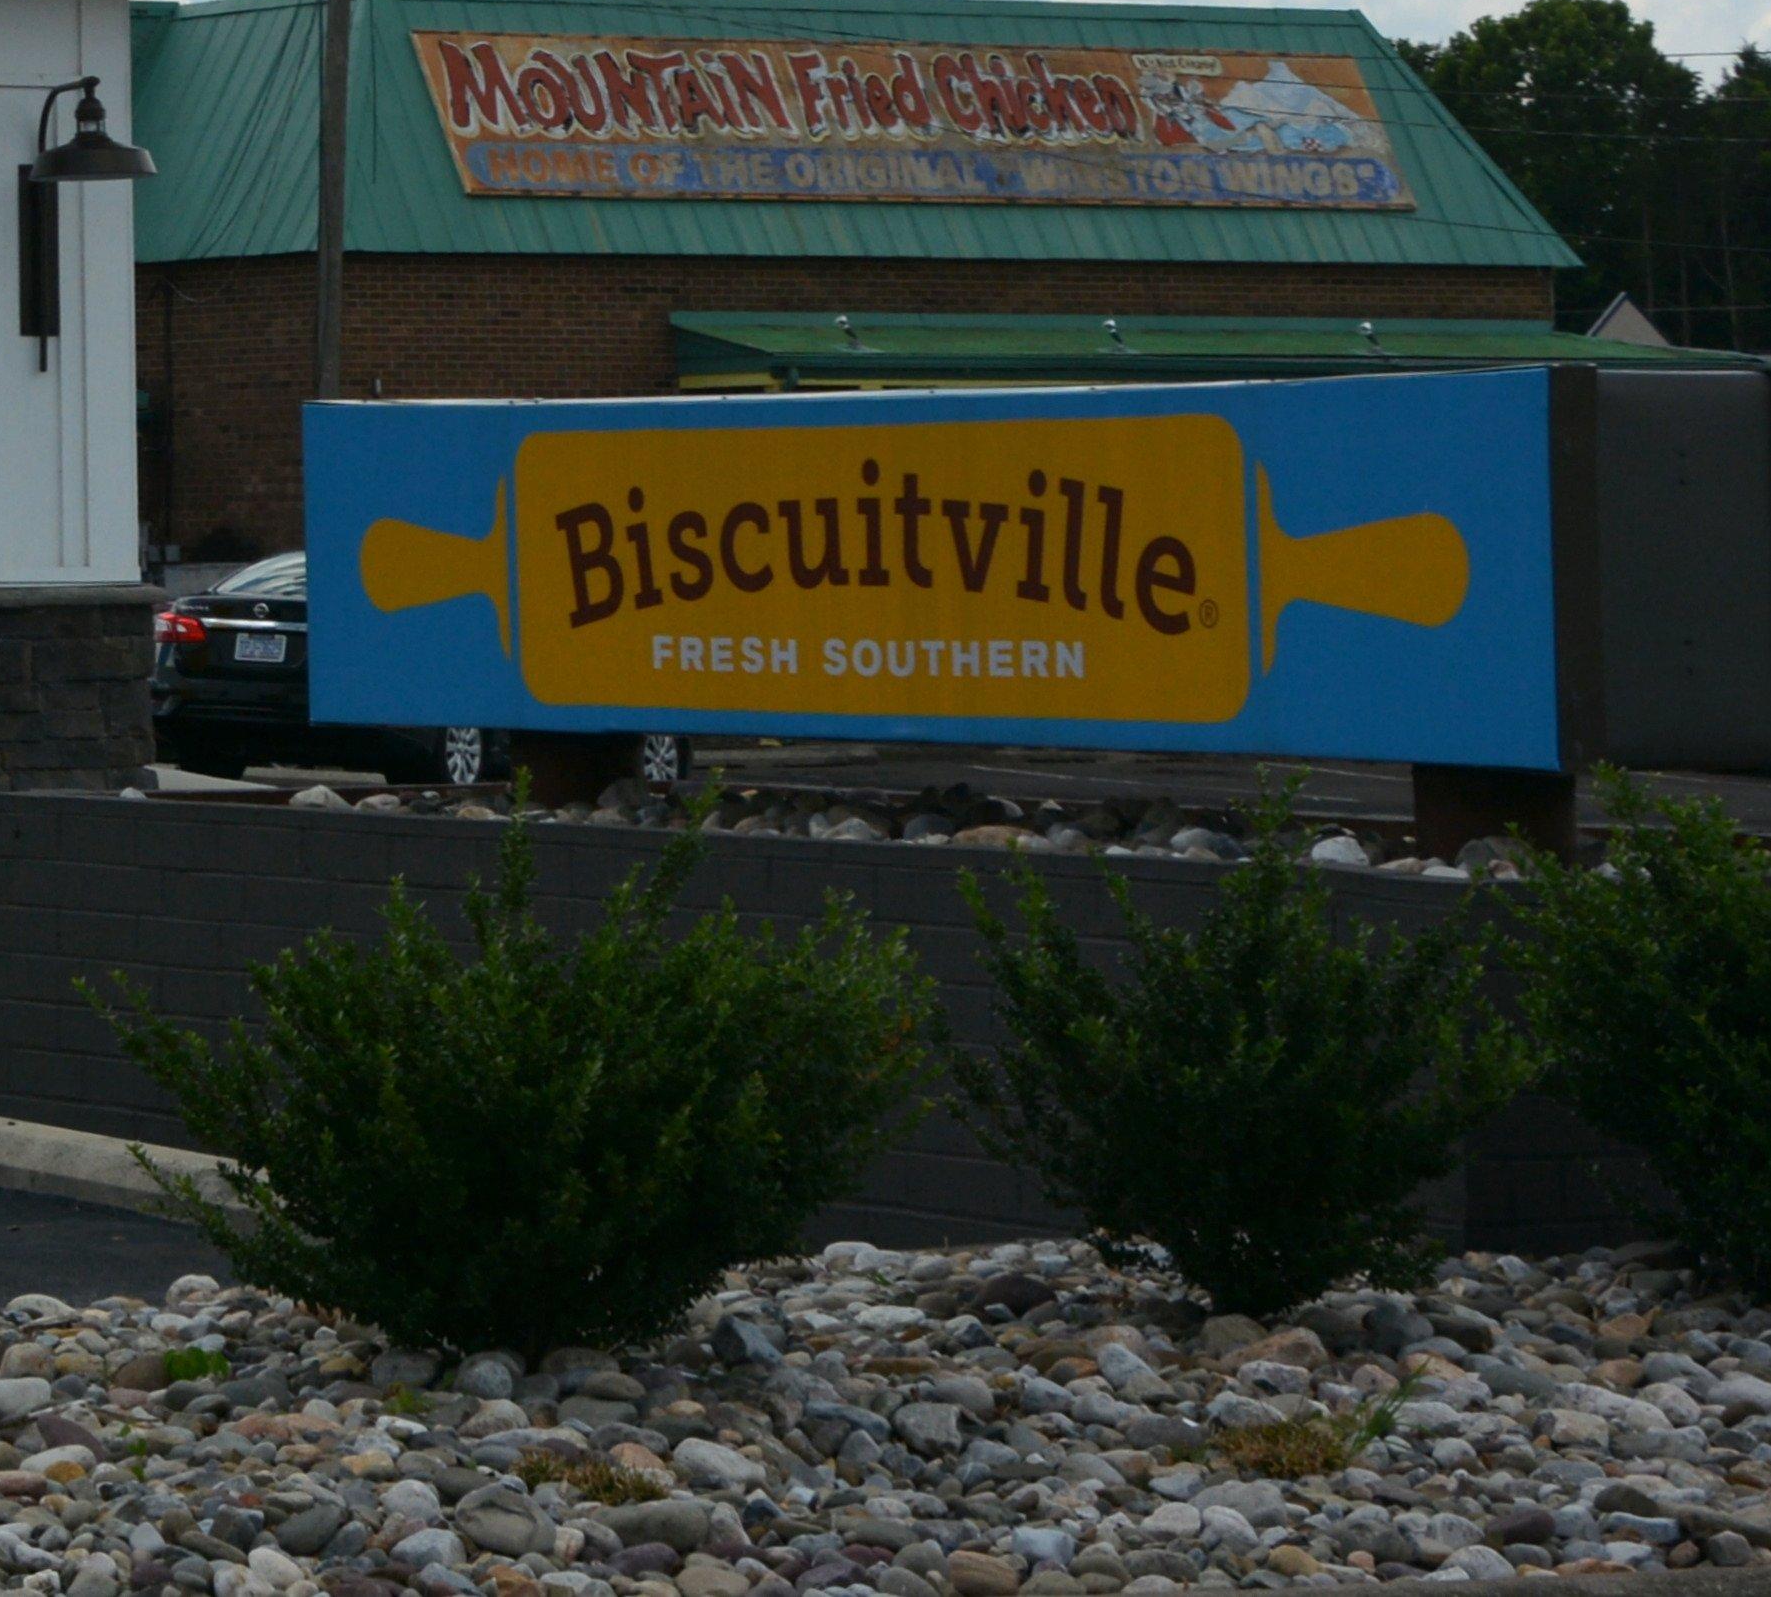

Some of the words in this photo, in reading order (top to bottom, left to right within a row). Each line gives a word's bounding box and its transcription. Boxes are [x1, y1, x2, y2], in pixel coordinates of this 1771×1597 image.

[788, 47, 937, 140] Fried
[934, 51, 1143, 144] Chicken
[486, 147, 620, 185] HOME
[627, 150, 687, 186] OF
[698, 151, 775, 188] THE
[784, 153, 988, 194] ORIGINAL
[555, 458, 1198, 637] Biscuitville
[652, 634, 800, 675] FRESH
[822, 638, 1085, 679] SOUTHERN
